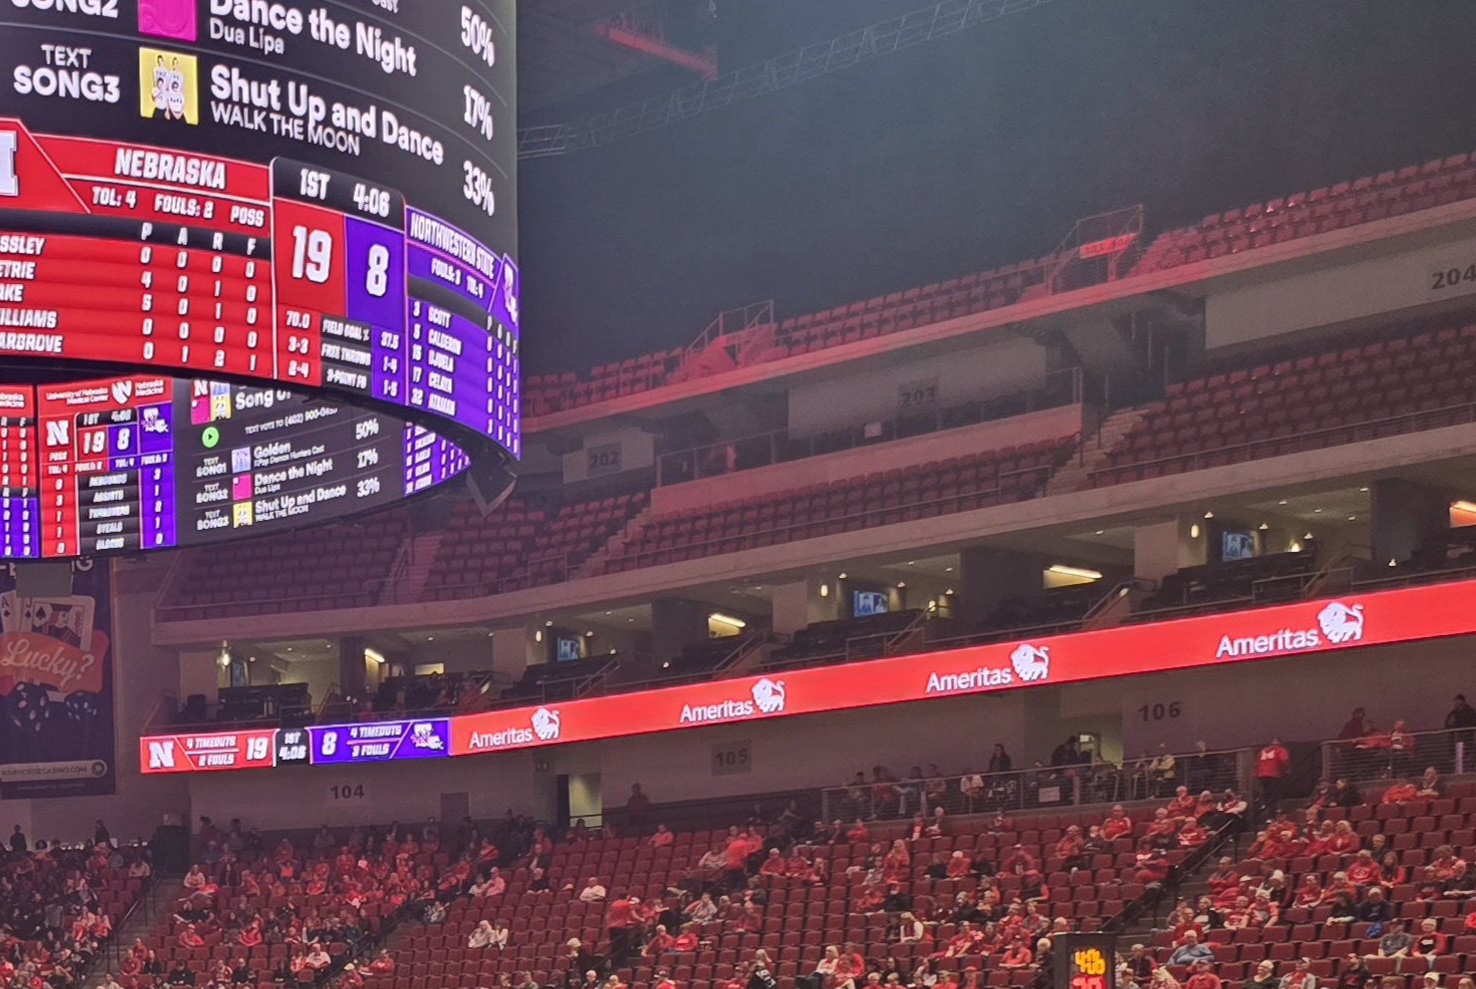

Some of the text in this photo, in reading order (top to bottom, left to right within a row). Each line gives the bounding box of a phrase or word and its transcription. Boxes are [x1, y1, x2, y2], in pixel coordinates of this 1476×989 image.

[209, 18, 285, 55] Dua Lipa
[308, 8, 351, 49] the
[356, 22, 417, 77] Night
[461, 5, 495, 67] 50%
[41, 44, 92, 69] TEXT
[14, 65, 120, 104] SONG3
[211, 64, 444, 165] Shut Up and Dance
[463, 85, 494, 140] 17%
[211, 100, 361, 156] WALK THE MOON
[114, 148, 226, 190] NEBRASKA
[300, 168, 390, 218] 1ST 4:06
[463, 160, 495, 217] 33%
[92, 187, 265, 228] TOL: FOULS: POSS
[291, 225, 332, 284] 19
[365, 244, 389, 297] 8
[1431, 264, 1476, 290] 204
[285, 309, 311, 330] 70.0
[235, 390, 274, 409] Song
[46, 420, 70, 446] N
[83, 431, 106, 454] 19
[254, 443, 291, 460] Golden
[590, 451, 619, 469] 202
[305, 459, 333, 477] Night
[1216, 629, 1318, 658] Ameritas
[926, 668, 1011, 693] Ameritas
[680, 699, 753, 723] Ameritas
[1138, 703, 1182, 721] 106
[195, 736, 236, 748] TIMEOUTS
[285, 731, 301, 744] 1ST
[359, 724, 402, 738] TIMEOUTS
[469, 728, 533, 749] Ameritas
[149, 741, 174, 768] N
[247, 737, 268, 761] 19
[279, 745, 306, 761] 4:06
[322, 732, 337, 755] 8
[361, 743, 390, 757] FOULS
[208, 754, 234, 766] FOULS
[714, 750, 748, 766] 105
[331, 785, 365, 799] 104
[1075, 949, 1105, 975] 4:06
